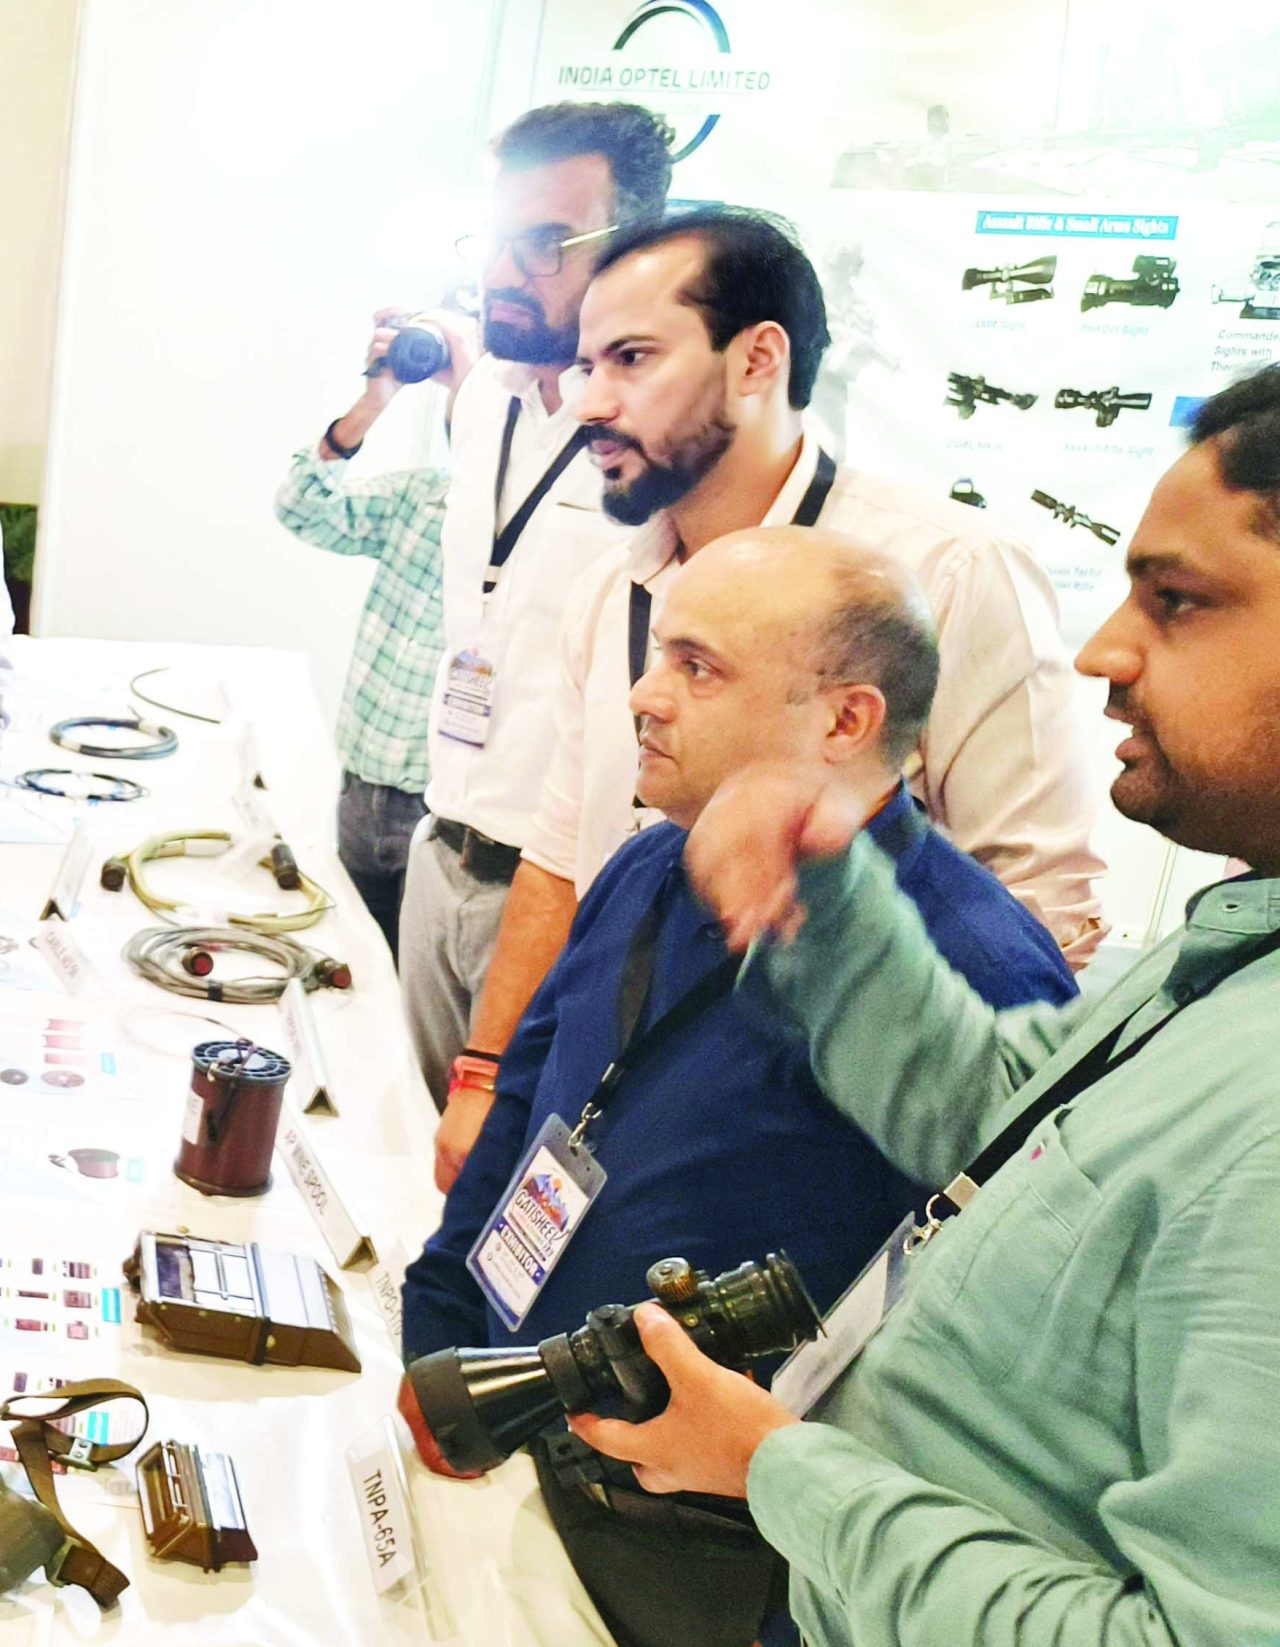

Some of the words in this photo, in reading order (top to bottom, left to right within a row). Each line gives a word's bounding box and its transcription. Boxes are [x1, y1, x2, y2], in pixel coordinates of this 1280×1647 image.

[558, 66, 612, 86] INDIA
[619, 67, 681, 88] OPTEL
[688, 69, 771, 90] LIMITED
[1053, 217, 1064, 231] &
[1065, 216, 1098, 232] Small
[1100, 218, 1130, 233] Arms
[1132, 219, 1169, 237] Sights
[1218, 329, 1280, 341] Commande
[1214, 345, 1247, 357] Sights
[1250, 347, 1272, 356] with
[303, 1169, 328, 1216] SPOOL
[500, 1225, 539, 1277] EXHIBITOR
[363, 1468, 397, 1568] TNPA-65A
